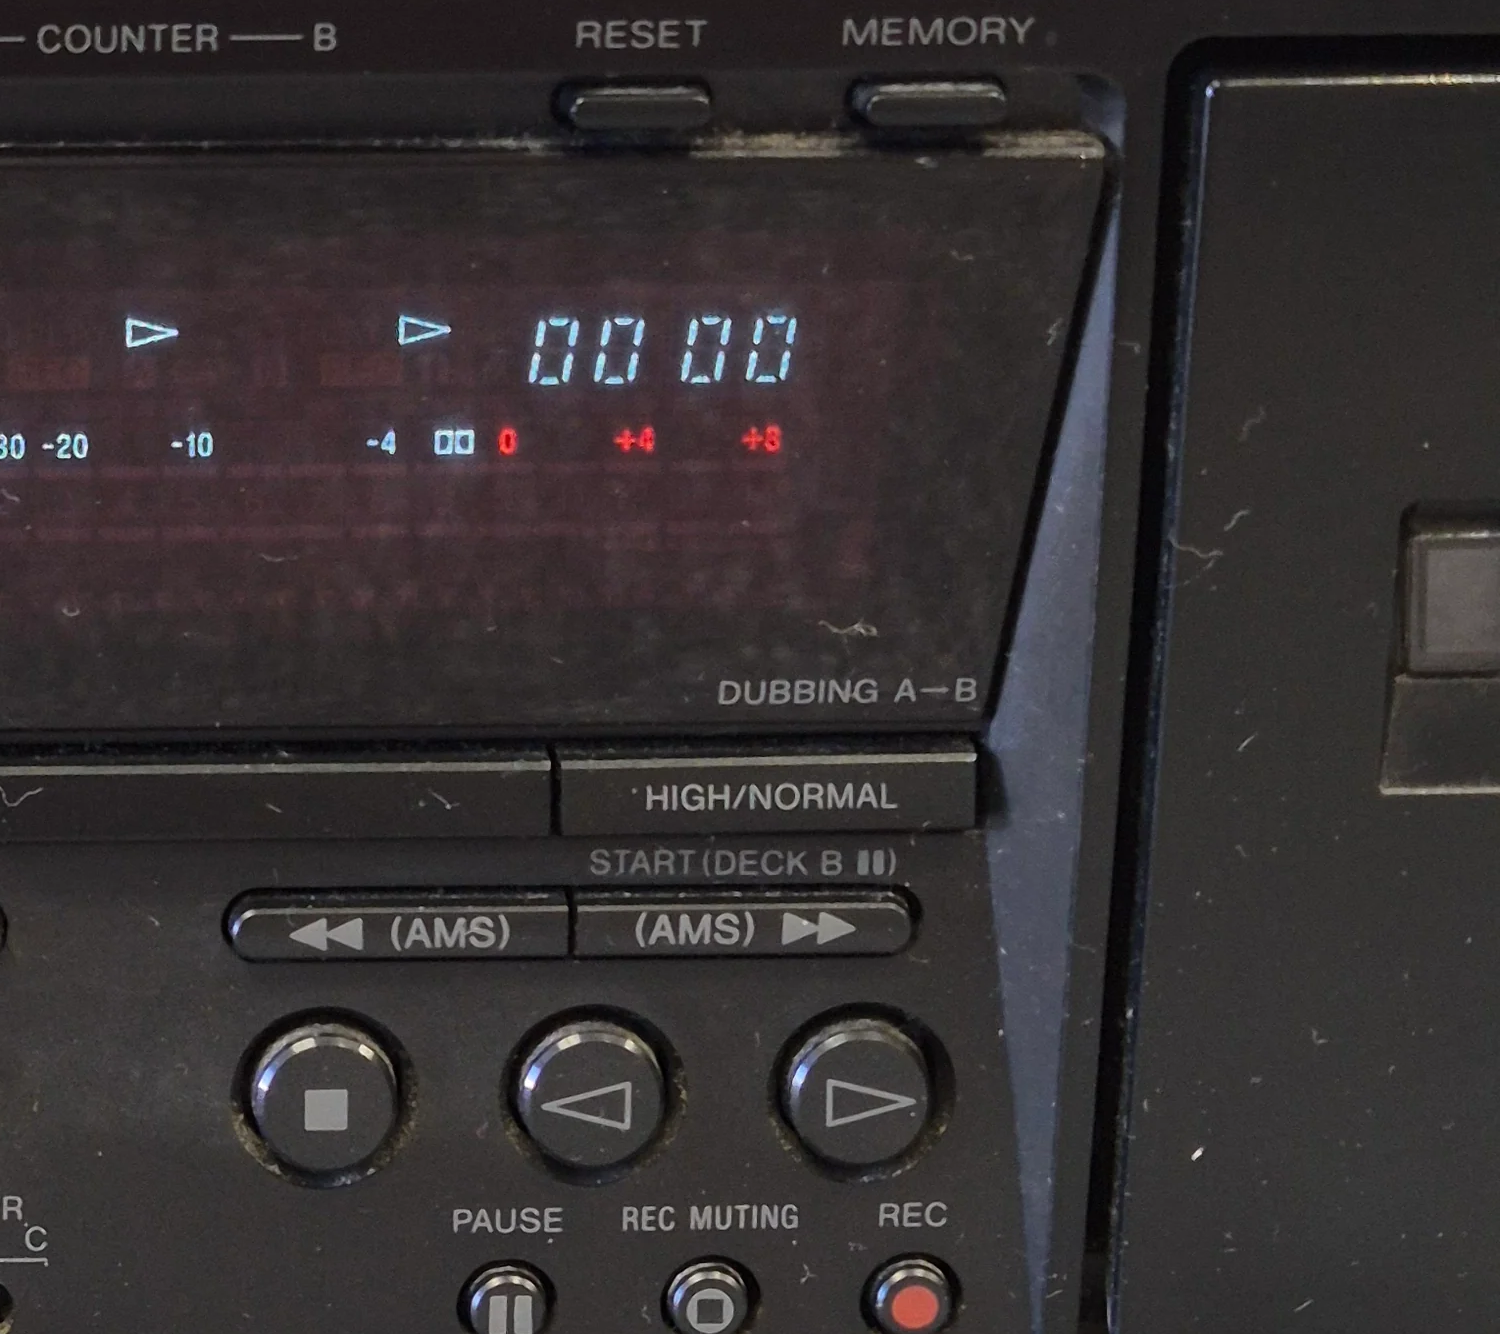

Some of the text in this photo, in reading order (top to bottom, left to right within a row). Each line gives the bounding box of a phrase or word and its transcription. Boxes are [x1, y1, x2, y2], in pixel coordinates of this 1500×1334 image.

[36, 23, 219, 54] COUNTER
[313, 22, 337, 52] B
[576, 19, 708, 50] RESET
[842, 16, 1035, 47] MEMORY
[42, 433, 89, 459] -20
[171, 431, 214, 458] -10
[366, 429, 396, 455] -4
[498, 427, 517, 455] 0
[717, 678, 878, 706] DUBBING
[646, 782, 898, 812] HIGH/NORMAL
[820, 849, 843, 876] B
[390, 913, 510, 952] (AMS)
[635, 910, 755, 948] (AMS)
[452, 1207, 563, 1234] PAUSE
[622, 1203, 799, 1232] REC MUTING
[878, 1201, 948, 1228] REC
[24, 1225, 48, 1252] C
